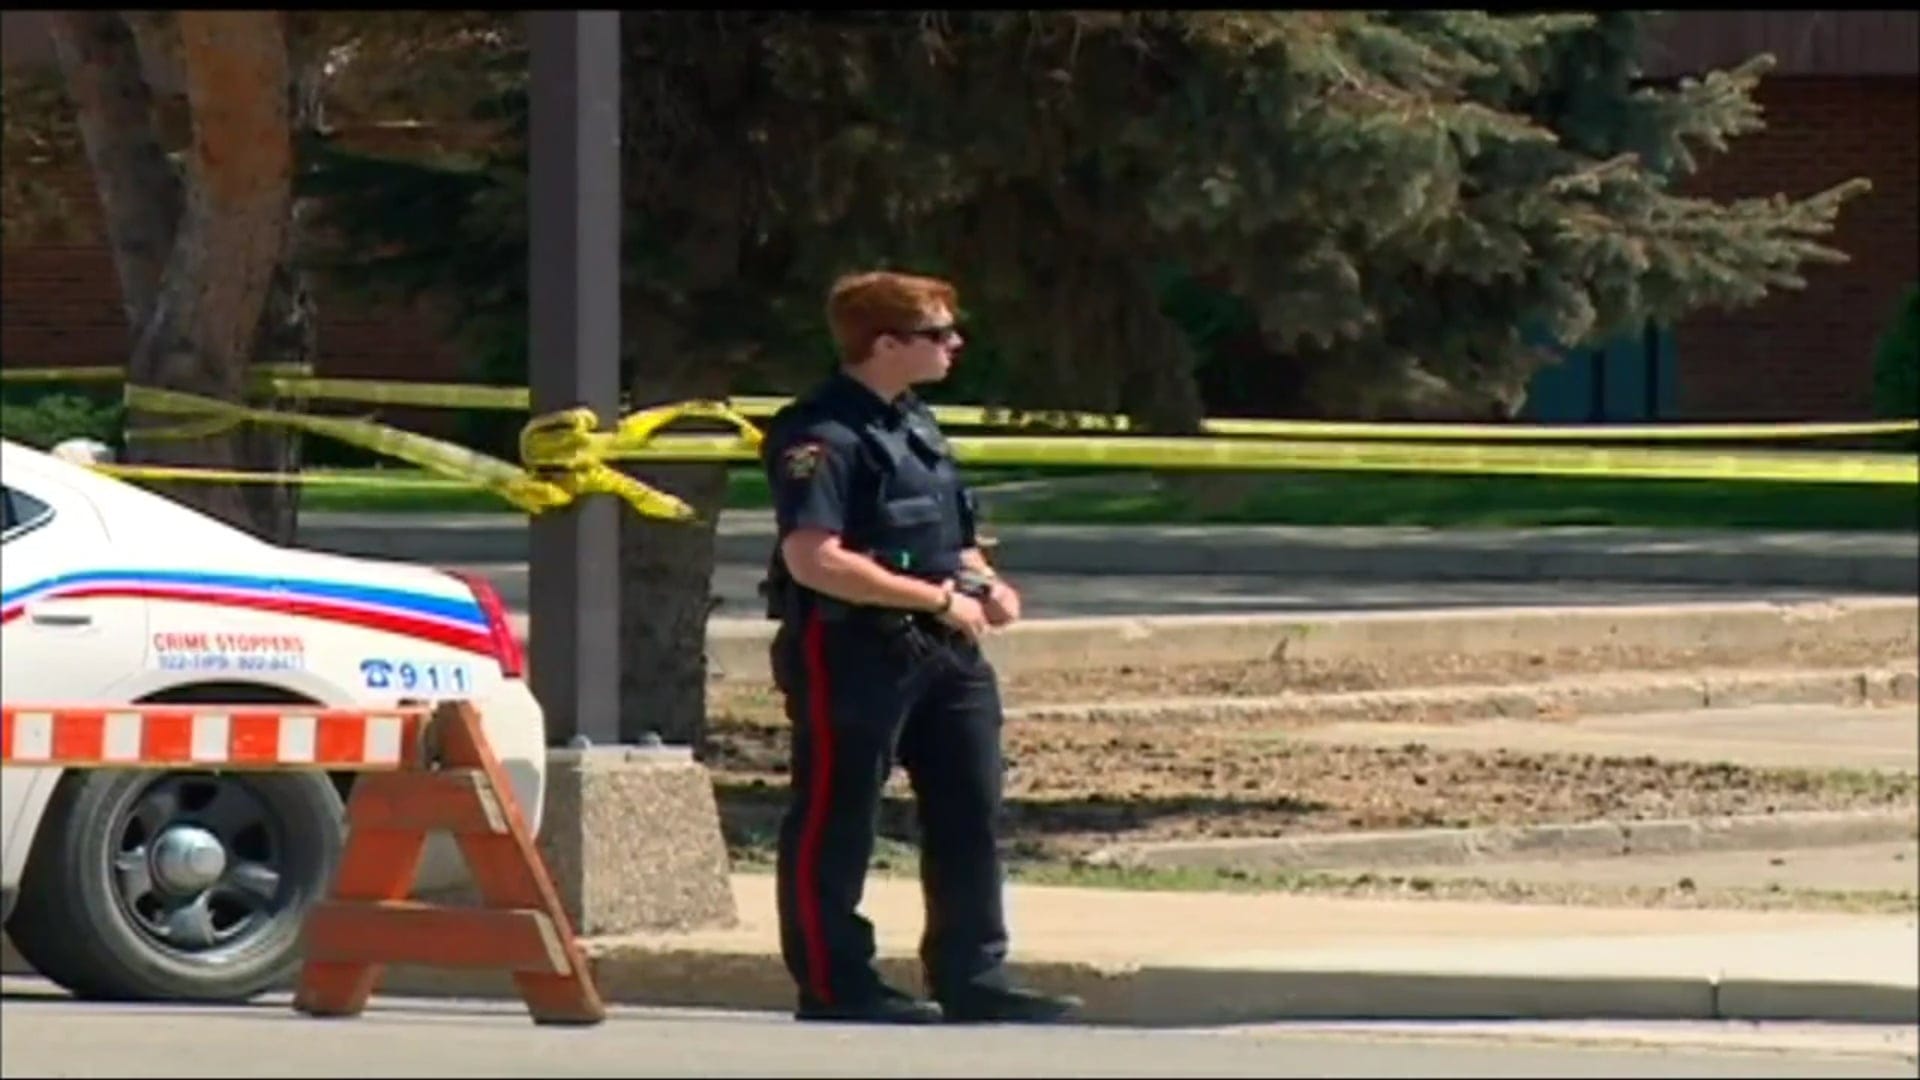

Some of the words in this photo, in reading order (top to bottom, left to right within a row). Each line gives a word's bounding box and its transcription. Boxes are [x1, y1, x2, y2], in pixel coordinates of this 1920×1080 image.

[153, 633, 210, 652] CRIME
[215, 633, 305, 653] STOPPERS
[399, 662, 464, 690] 911
